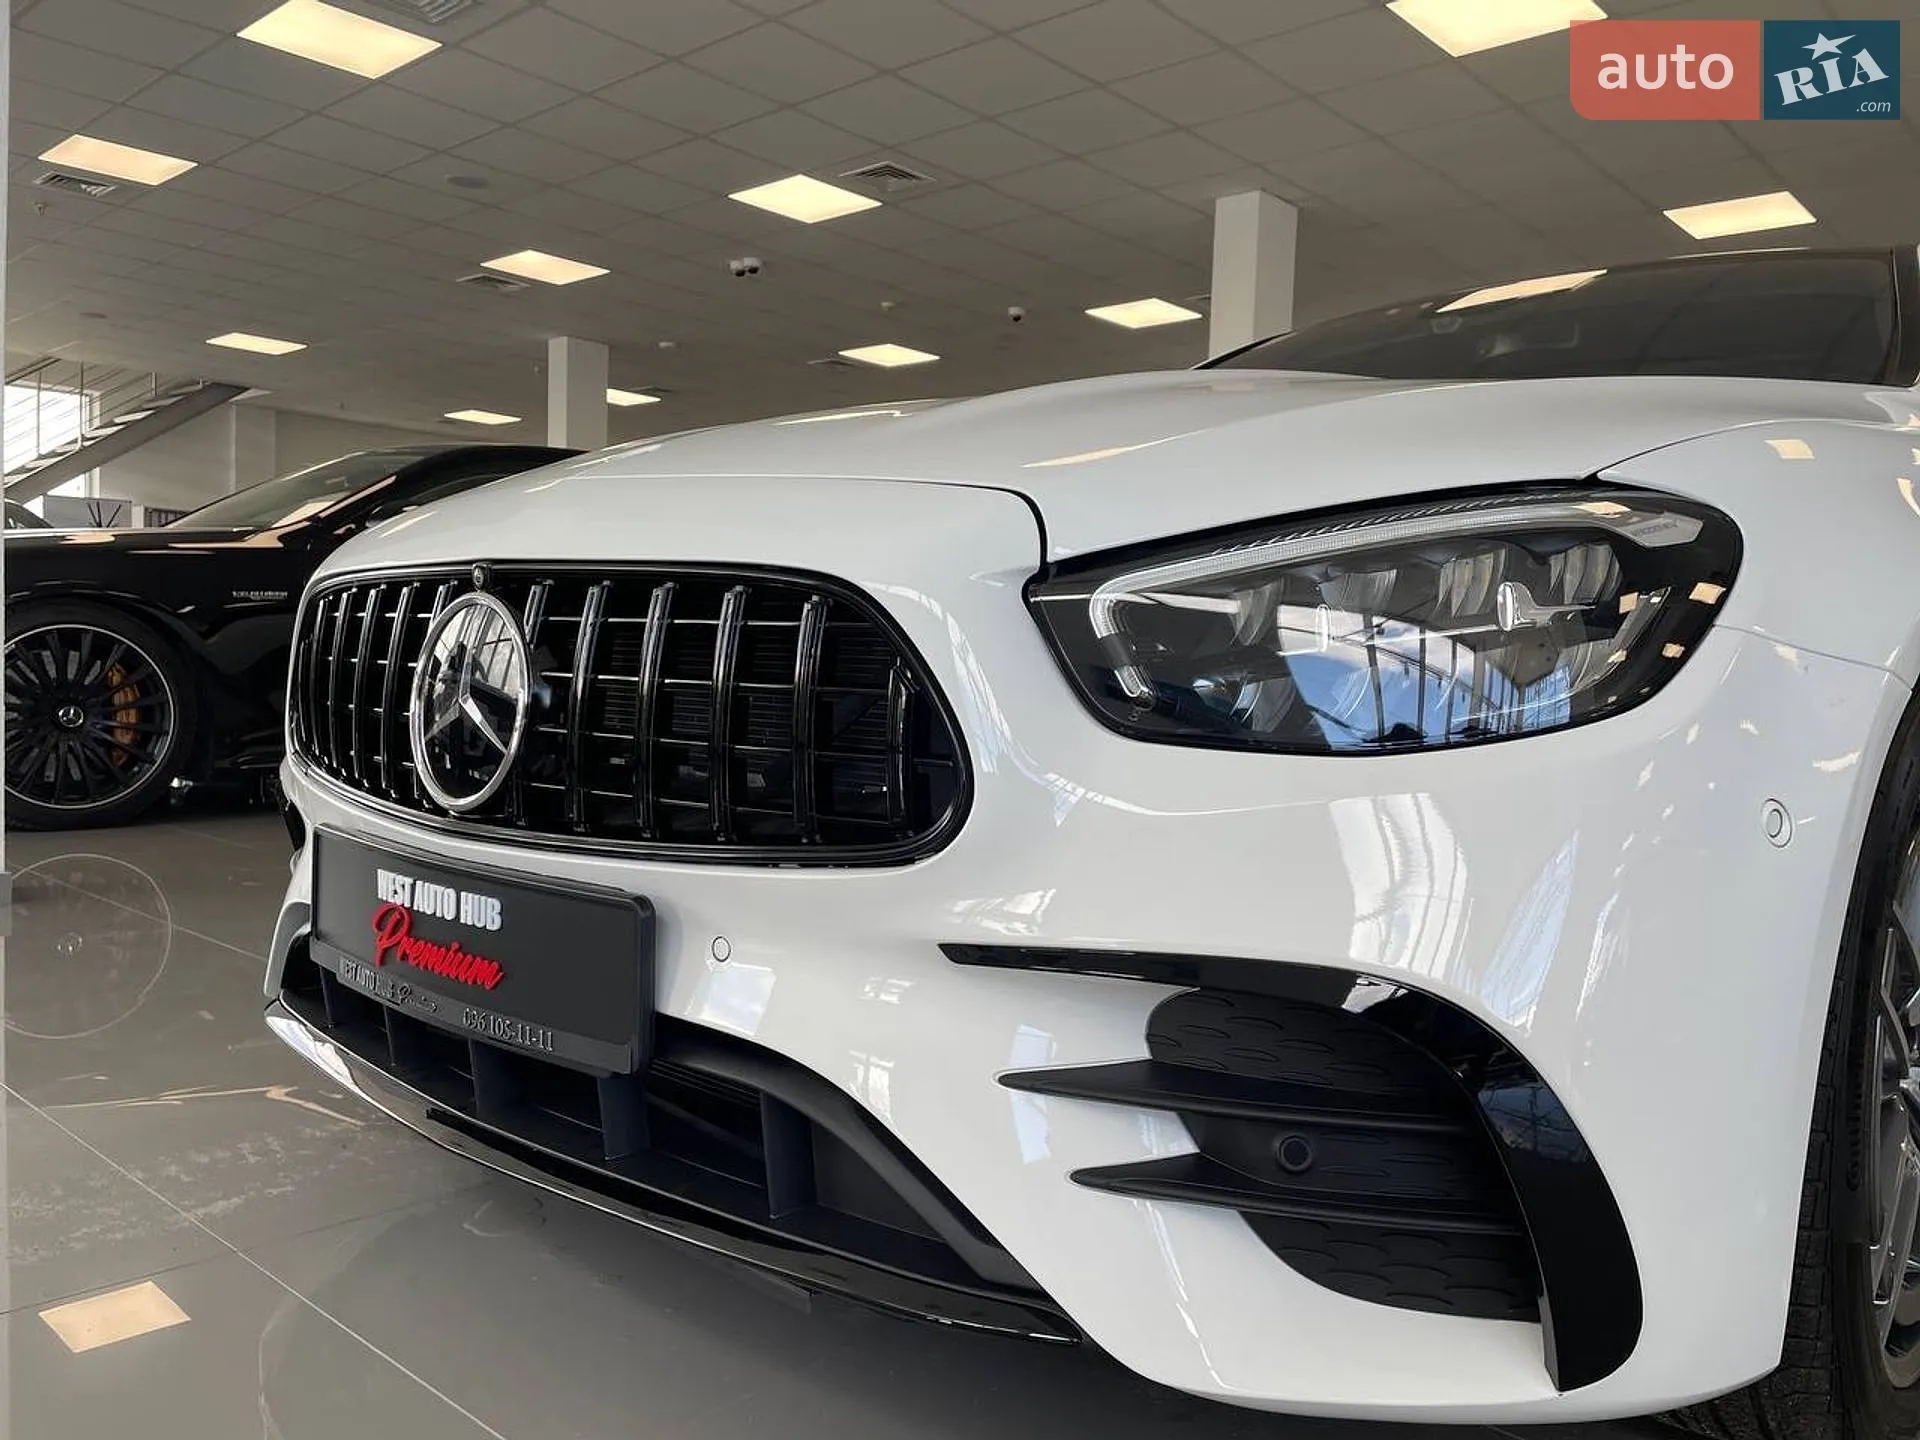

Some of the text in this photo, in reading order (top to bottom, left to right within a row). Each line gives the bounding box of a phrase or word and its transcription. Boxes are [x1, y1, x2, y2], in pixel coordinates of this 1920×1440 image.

[377, 869, 502, 931] WEST AUTO HUB
[372, 903, 504, 990] Premium
